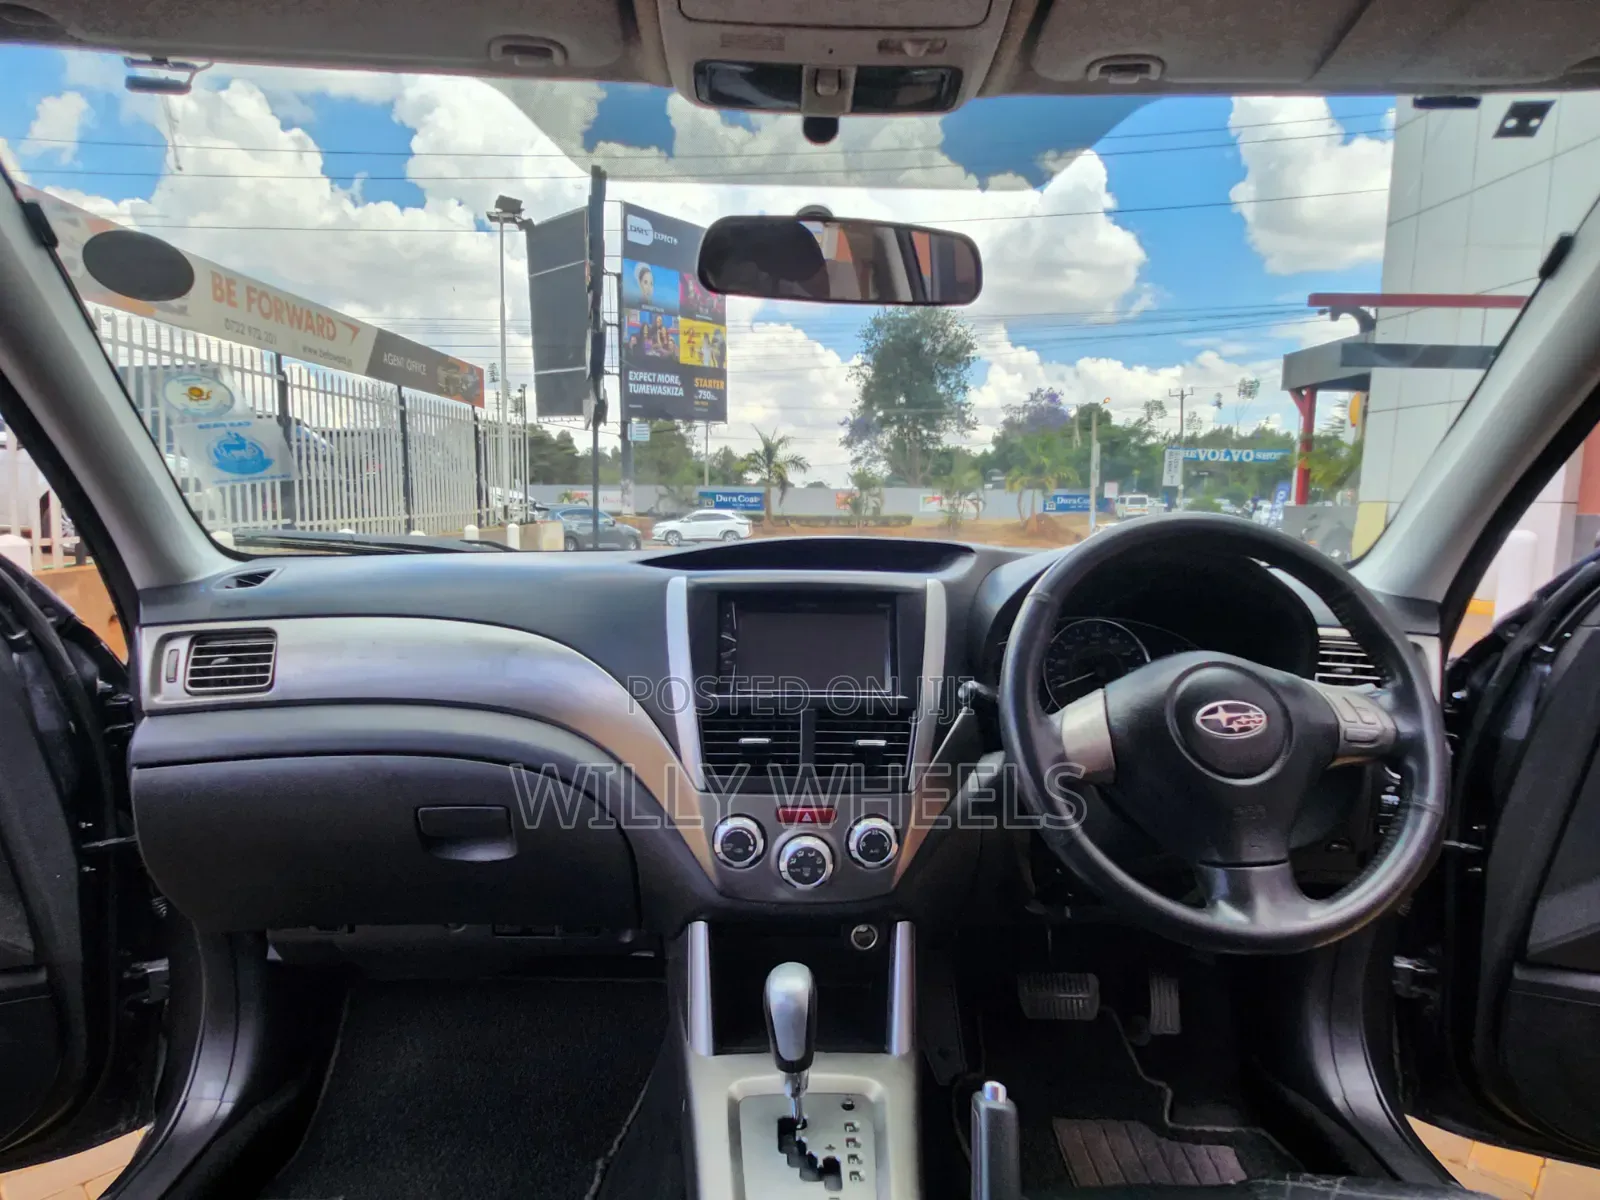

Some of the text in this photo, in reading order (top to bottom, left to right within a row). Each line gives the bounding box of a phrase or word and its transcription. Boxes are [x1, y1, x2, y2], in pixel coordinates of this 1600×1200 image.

[210, 270, 337, 341] BE FORWARD
[383, 352, 427, 376] AGENT OFFICE
[628, 370, 682, 386] EXPECT MORE,
[693, 377, 725, 390] STARTER
[628, 383, 684, 397] TUMEWASKIZA
[1197, 448, 1255, 461] VOLVO
